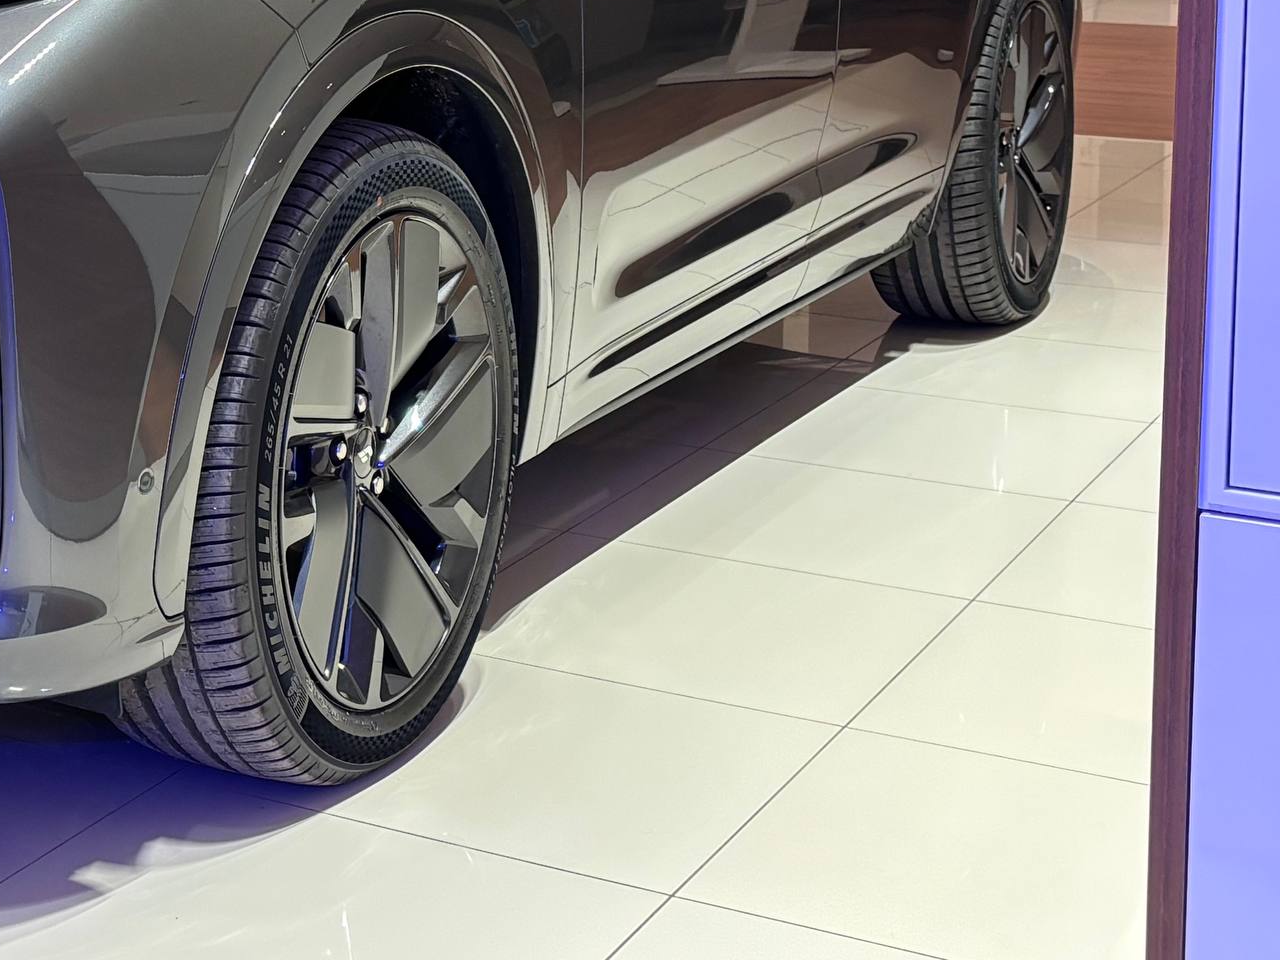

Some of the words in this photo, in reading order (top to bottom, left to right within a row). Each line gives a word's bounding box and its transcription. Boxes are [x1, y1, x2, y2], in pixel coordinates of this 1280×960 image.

[264, 382, 281, 463] 265/45
[277, 362, 286, 378] R
[283, 333, 293, 359] 21
[258, 482, 291, 676] MICHELIN
